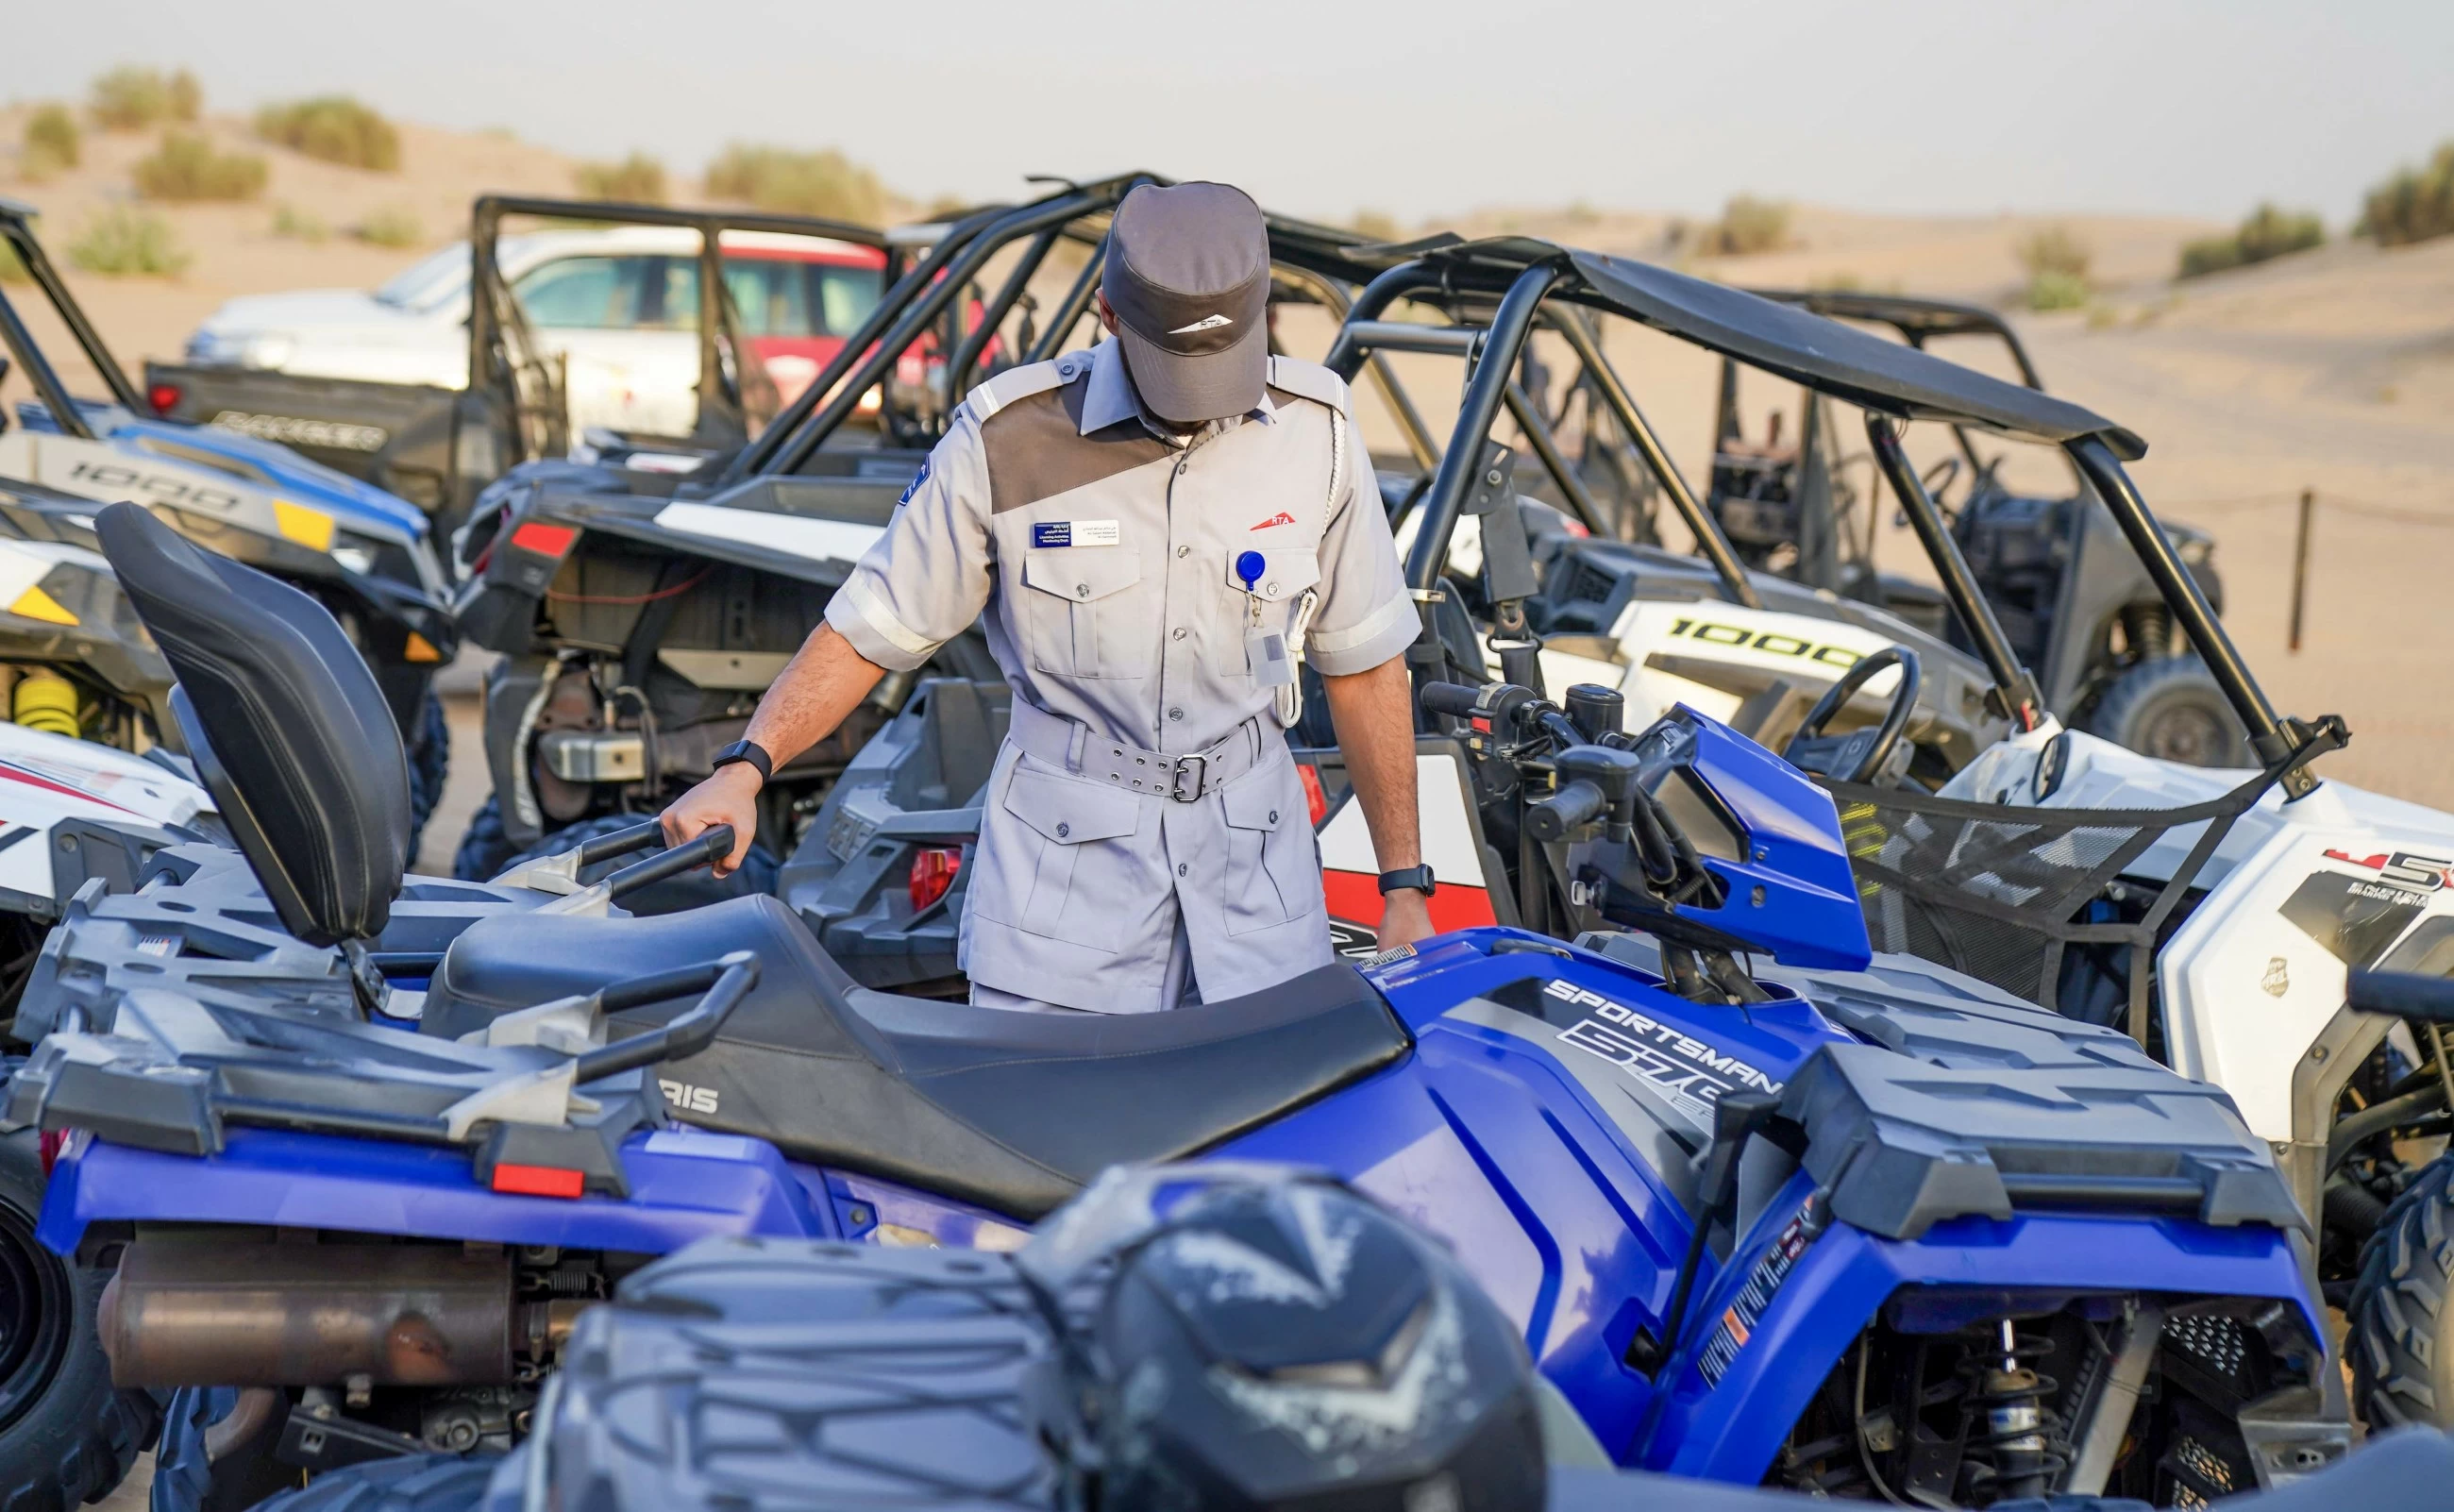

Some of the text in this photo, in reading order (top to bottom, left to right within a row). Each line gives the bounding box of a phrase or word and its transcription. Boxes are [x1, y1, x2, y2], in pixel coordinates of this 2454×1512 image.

[69, 461, 240, 512] 1000
[1270, 515, 1290, 525] RTA
[1669, 618, 1868, 668] 1000
[1543, 978, 1785, 1095] SPORTSMAN
